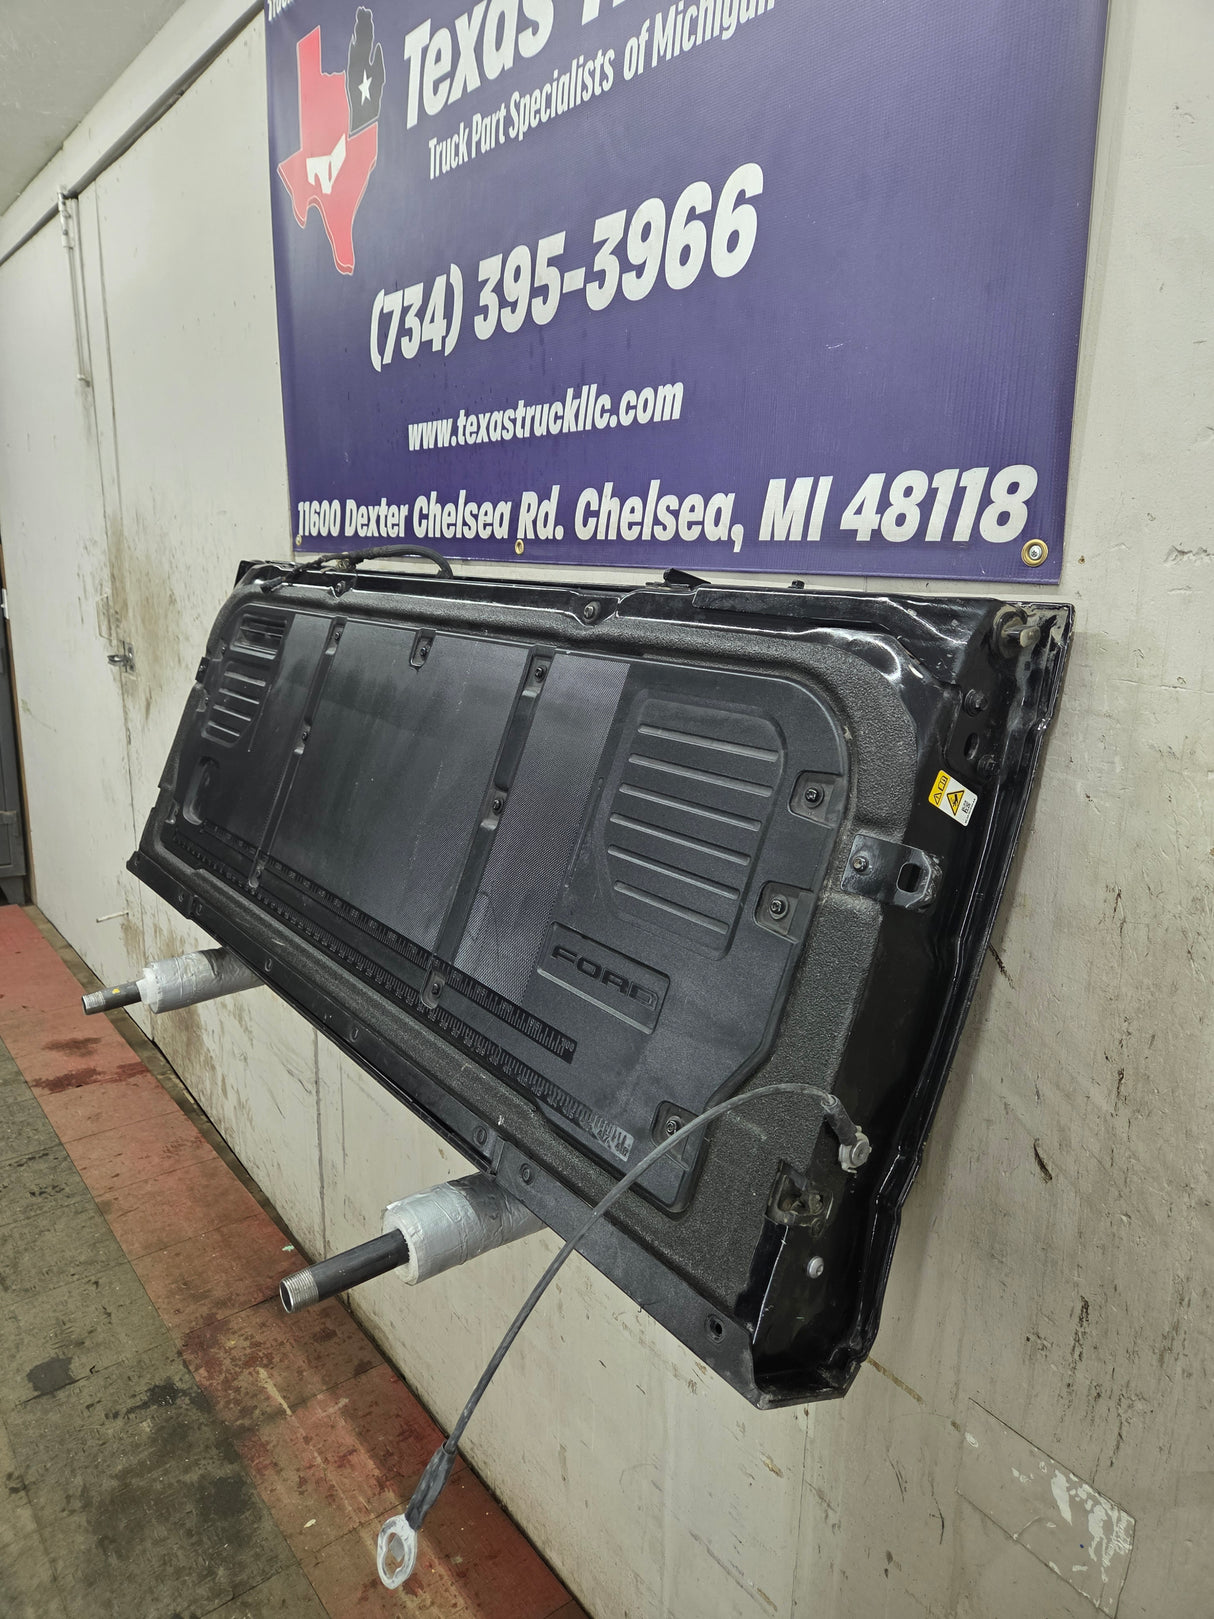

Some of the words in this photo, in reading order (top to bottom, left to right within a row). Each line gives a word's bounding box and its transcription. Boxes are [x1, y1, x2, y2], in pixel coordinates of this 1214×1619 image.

[403, 0, 555, 131] Texas
[428, 120, 470, 180] Truck
[471, 102, 507, 159] Part
[508, 48, 615, 142] Specialists
[623, 18, 650, 81] of
[369, 262, 464, 373] (734)
[473, 162, 764, 341] 395-3966
[407, 380, 684, 451] www.texastruckllc.com
[297, 499, 341, 537] 11600
[344, 497, 409, 538] Dexter
[412, 489, 512, 540] Chelsea
[516, 484, 564, 541] Rd.
[574, 478, 745, 554] Chelsea,
[758, 474, 834, 542] MI
[839, 464, 1039, 544] 48118
[551, 945, 660, 1011] FORD
